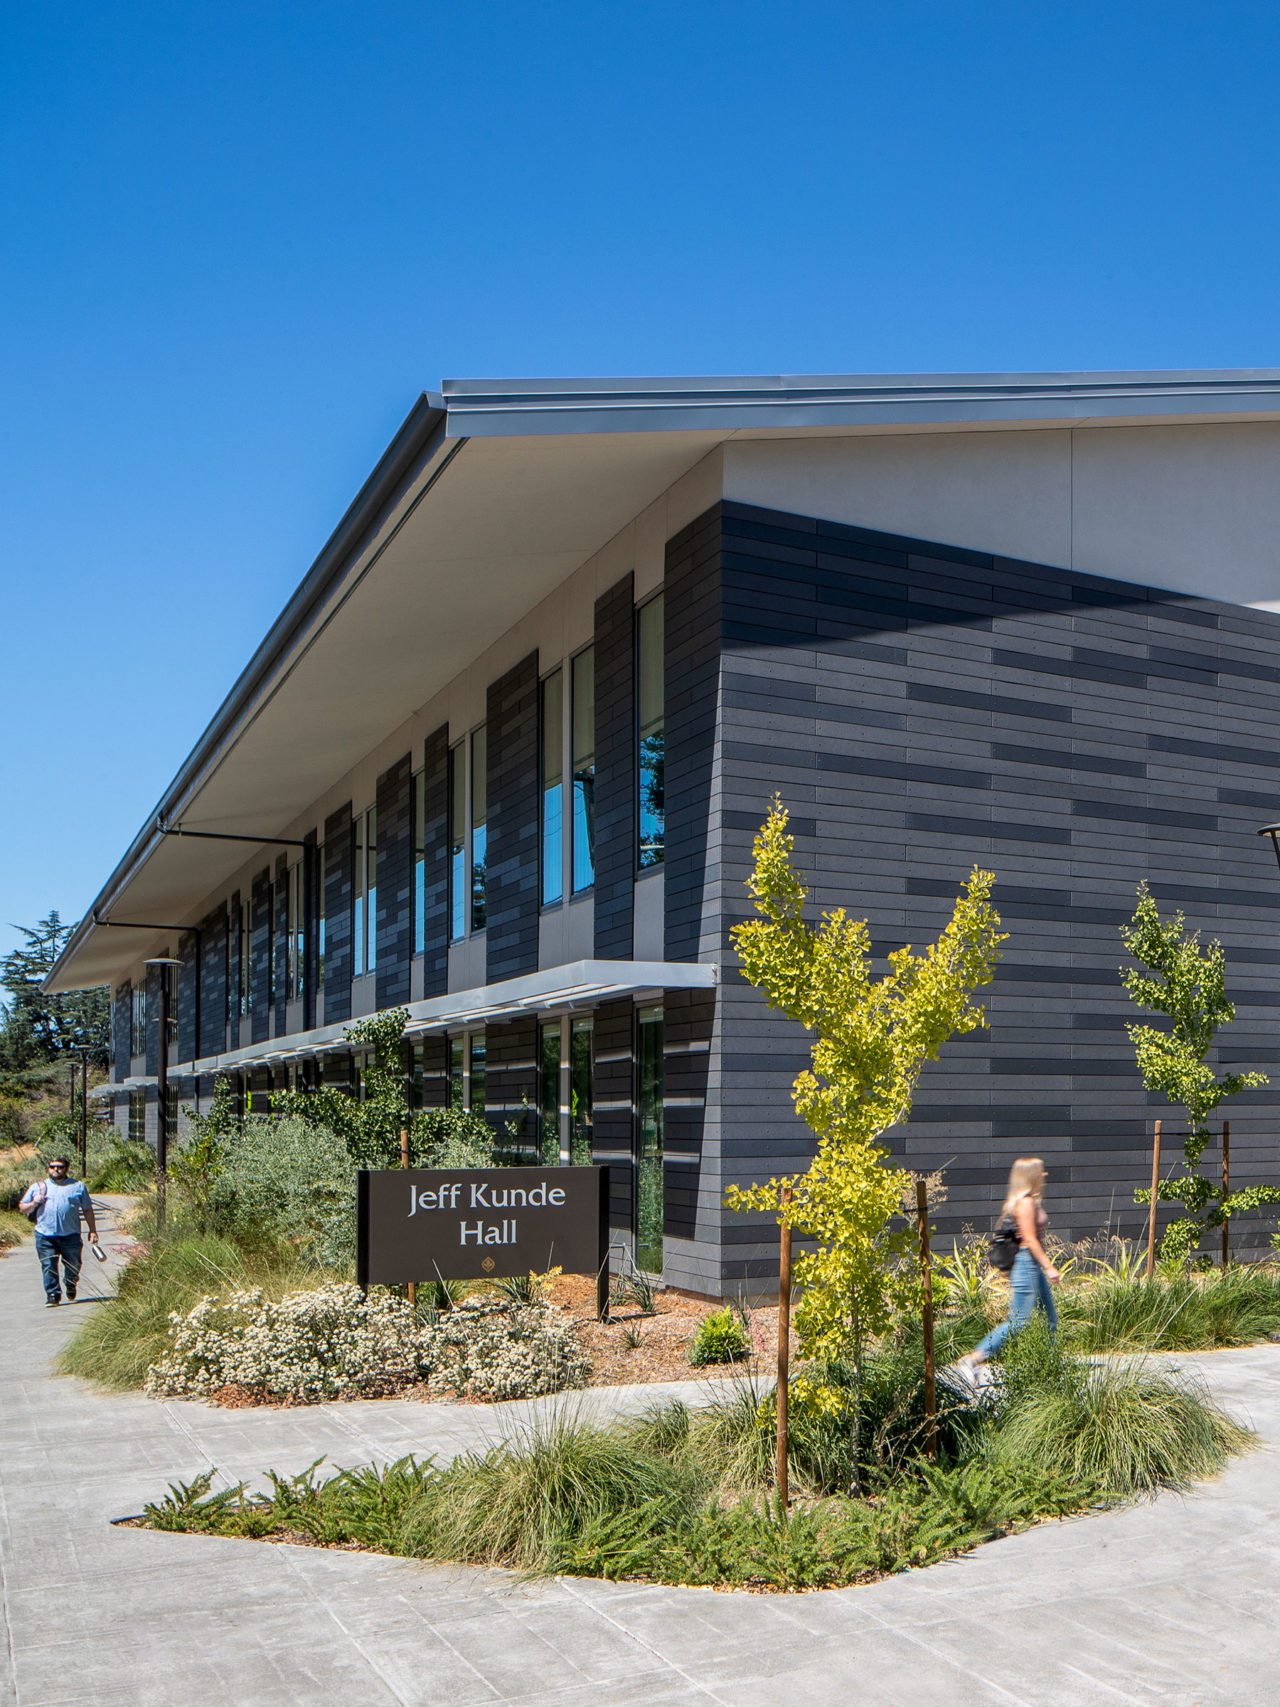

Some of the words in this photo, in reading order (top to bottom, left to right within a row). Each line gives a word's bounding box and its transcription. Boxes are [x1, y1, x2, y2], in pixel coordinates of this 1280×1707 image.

[407, 1183, 462, 1217] Jeff
[470, 1182, 566, 1208] Kunde
[460, 1219, 517, 1246] Hall
